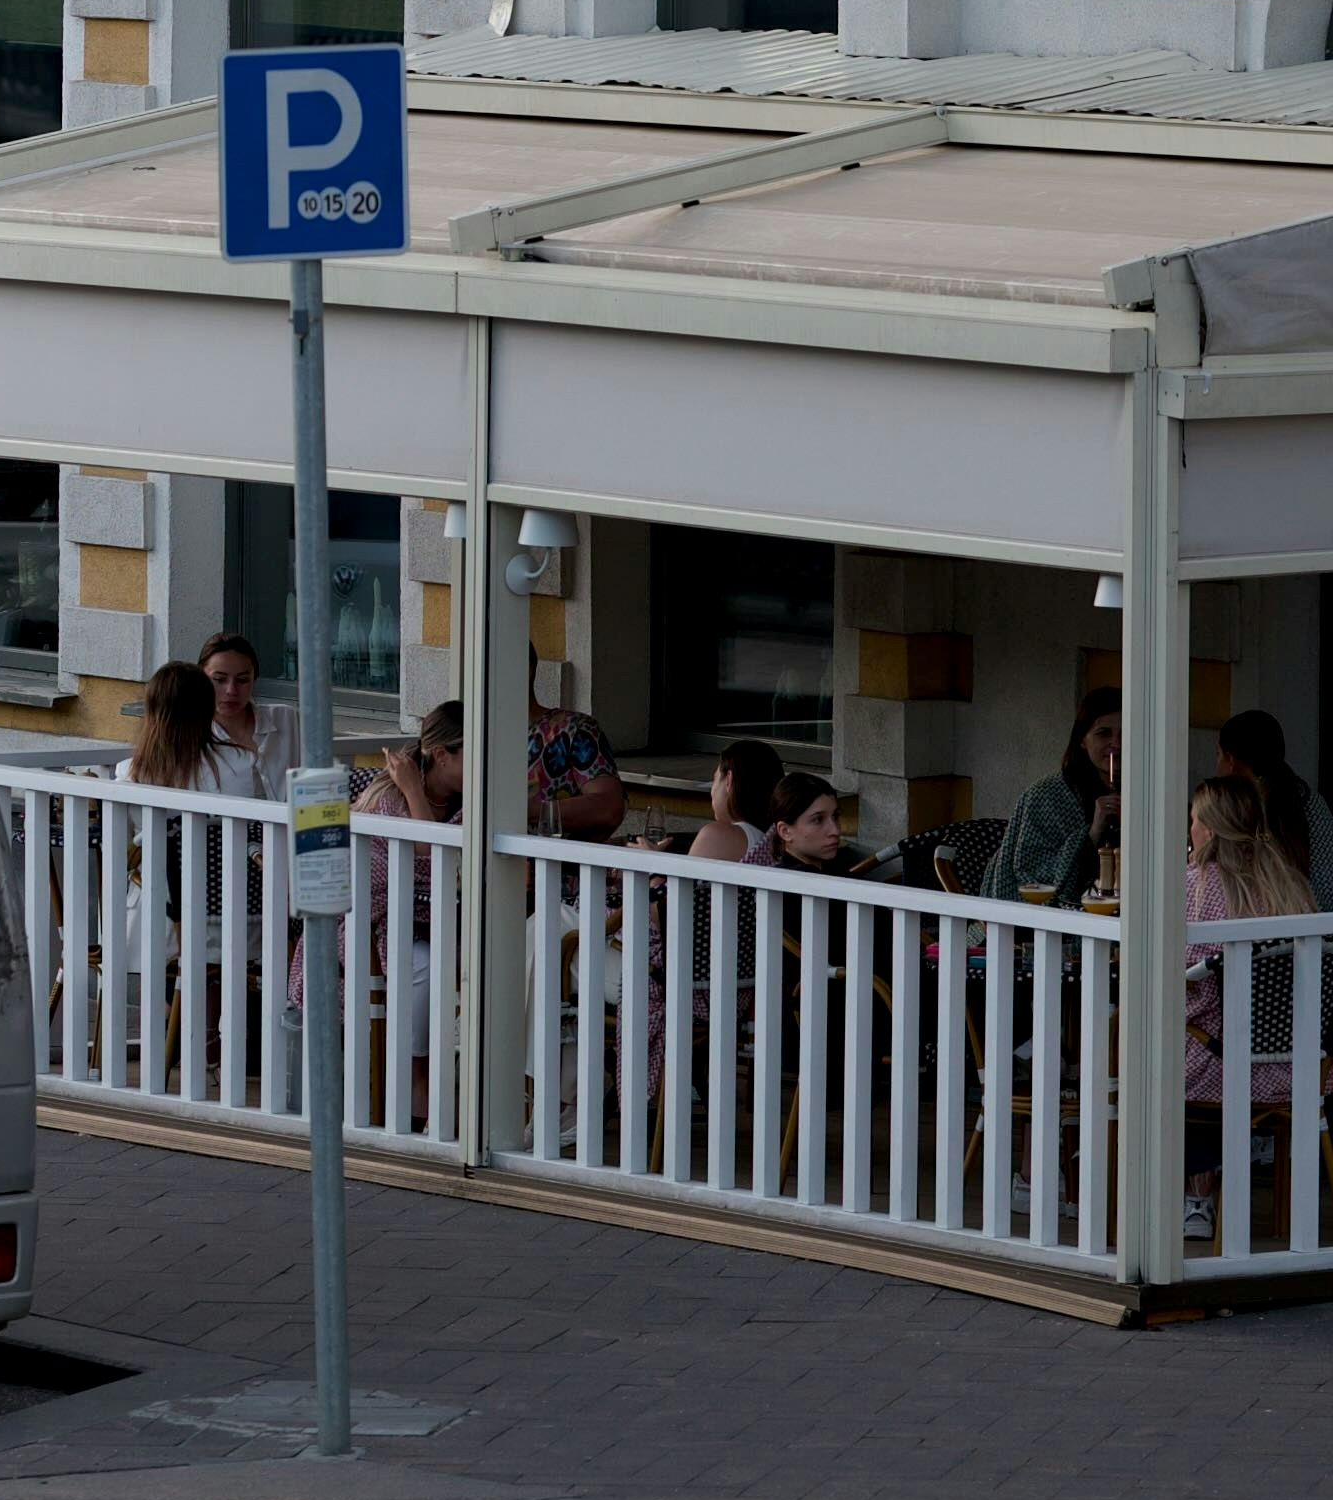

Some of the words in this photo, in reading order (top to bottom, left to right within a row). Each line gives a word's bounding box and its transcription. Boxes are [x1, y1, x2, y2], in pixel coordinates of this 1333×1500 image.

[266, 68, 363, 230] P
[303, 198, 318, 211] 10
[324, 194, 343, 213] 15
[352, 191, 379, 215] 20
